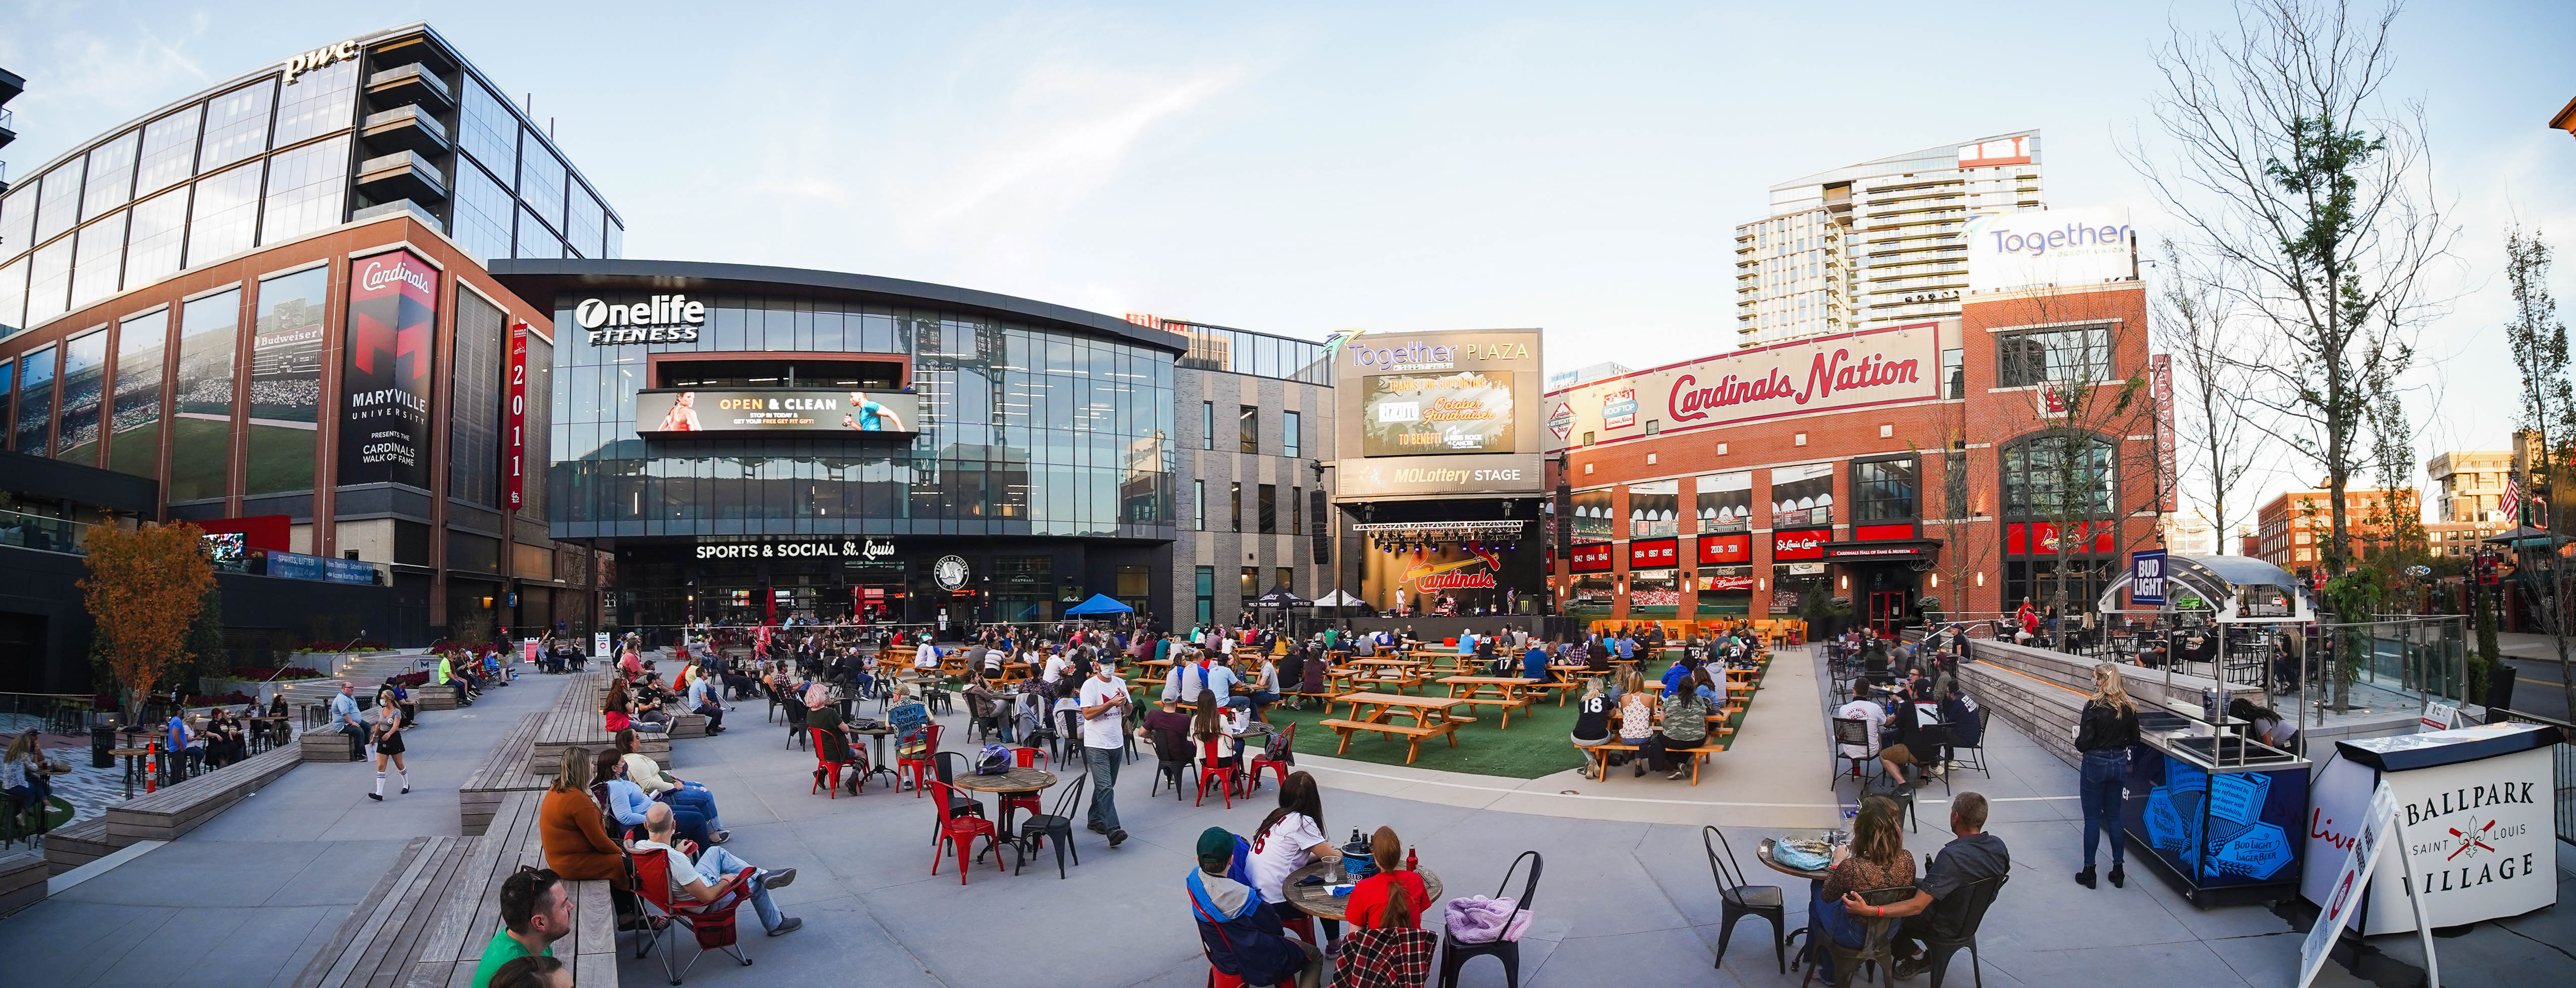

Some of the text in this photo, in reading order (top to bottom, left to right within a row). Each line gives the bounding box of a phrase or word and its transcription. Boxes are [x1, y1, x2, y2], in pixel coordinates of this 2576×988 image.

[282, 40, 355, 83] pwc
[1990, 223, 2129, 258] Together
[362, 261, 430, 294] Cardinals
[261, 331, 317, 346] Budweiser
[587, 327, 698, 343] FITNESS
[1348, 341, 1529, 371] Together PLAZA
[1550, 376, 1575, 390] KPMG
[2157, 361, 2166, 390] HALL
[1388, 378, 1486, 392] THANKS FOR SUPPORTING
[1669, 349, 1920, 422] Cardinals Nation
[353, 389, 426, 413] MARYVILLE
[720, 399, 837, 410] OPEN & CLEAN
[1434, 397, 1484, 410] October
[352, 408, 424, 425] UNIVERSITY
[1422, 409, 1496, 425] Fundraiser
[1604, 403, 1635, 416] ROOFTOP
[512, 365, 523, 476] 2011
[2160, 410, 2170, 438] FAME
[401, 433, 410, 441] THE
[1399, 432, 1442, 445] TO BENEFIT
[363, 442, 415, 457] CARDINALS
[2161, 441, 2171, 451] &
[363, 454, 385, 463] WALK
[398, 455, 414, 466] FAME
[1394, 468, 1521, 484] MOLottery STAGE
[696, 540, 895, 561] SPORTS & SOCIAL St. Louis
[1710, 544, 1738, 554] 2006 2011
[1784, 538, 1828, 551] Louis Cardi
[278, 555, 314, 566] SPIRITS, LIFTED
[1635, 550, 1645, 558] 1964
[936, 558, 949, 570] SPORTS
[2138, 559, 2159, 578] BUD
[1415, 564, 1497, 594] Cardinals
[1716, 579, 1753, 588] Budweiser
[2134, 578, 2163, 596] LIGHT
[897, 707, 916, 717] PARTY
[1584, 697, 1602, 713] 18
[896, 715, 918, 725] SQUAD
[2219, 782, 2243, 791] produced
[2221, 790, 2247, 802] refreshing.
[2221, 797, 2245, 809] lager with
[2212, 803, 2243, 817] drinkability.
[2405, 782, 2534, 827] BALLPARK
[2154, 815, 2175, 836] RENOWNED
[2493, 824, 2526, 841] LOUIS
[2234, 840, 2273, 850] BUD LIGHT
[2412, 840, 2448, 855] SAINT
[2236, 851, 2277, 862] LAGER BEER
